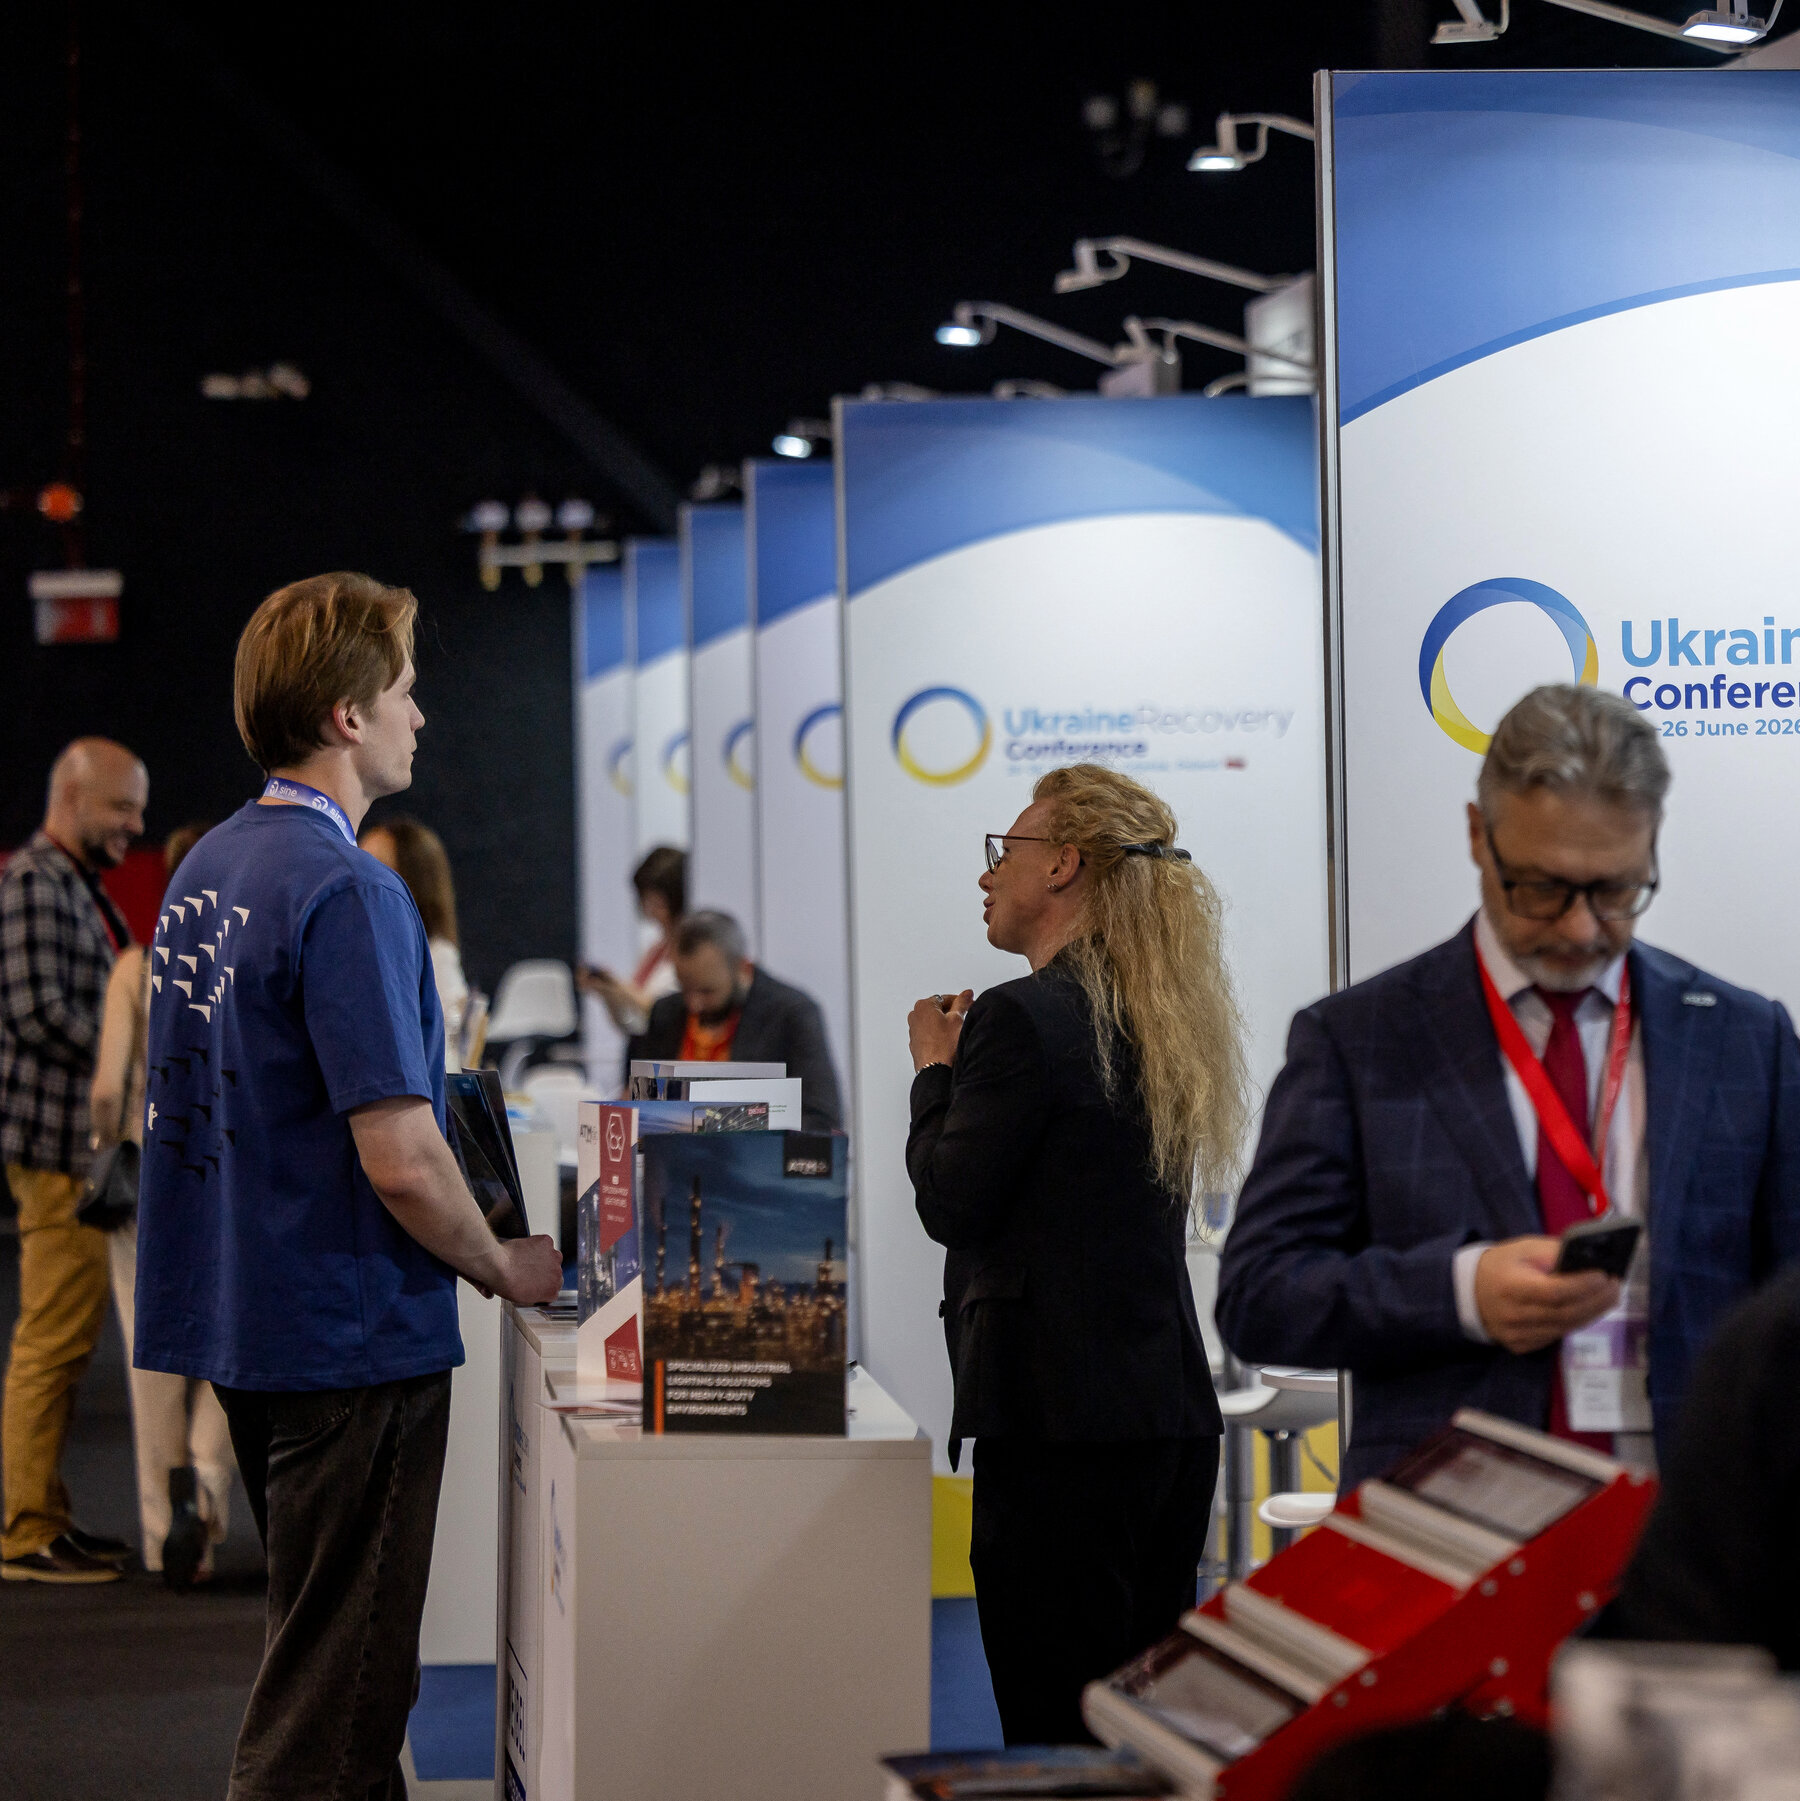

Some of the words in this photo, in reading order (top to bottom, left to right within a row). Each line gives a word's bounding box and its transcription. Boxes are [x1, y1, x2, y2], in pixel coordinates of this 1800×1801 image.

[1622, 673, 1800, 711] Confere
[1695, 719, 1749, 736] June
[1005, 740, 1149, 761] Conference
[279, 785, 297, 797] sine
[329, 808, 347, 828] sine
[731, 1361, 792, 1374] INDUSTRIAL
[666, 1374, 714, 1387] LIGHTING
[715, 1375, 772, 1388] SOLUTIONS
[666, 1388, 689, 1401] FOR
[666, 1402, 748, 1416] ENVIRONMENTS
